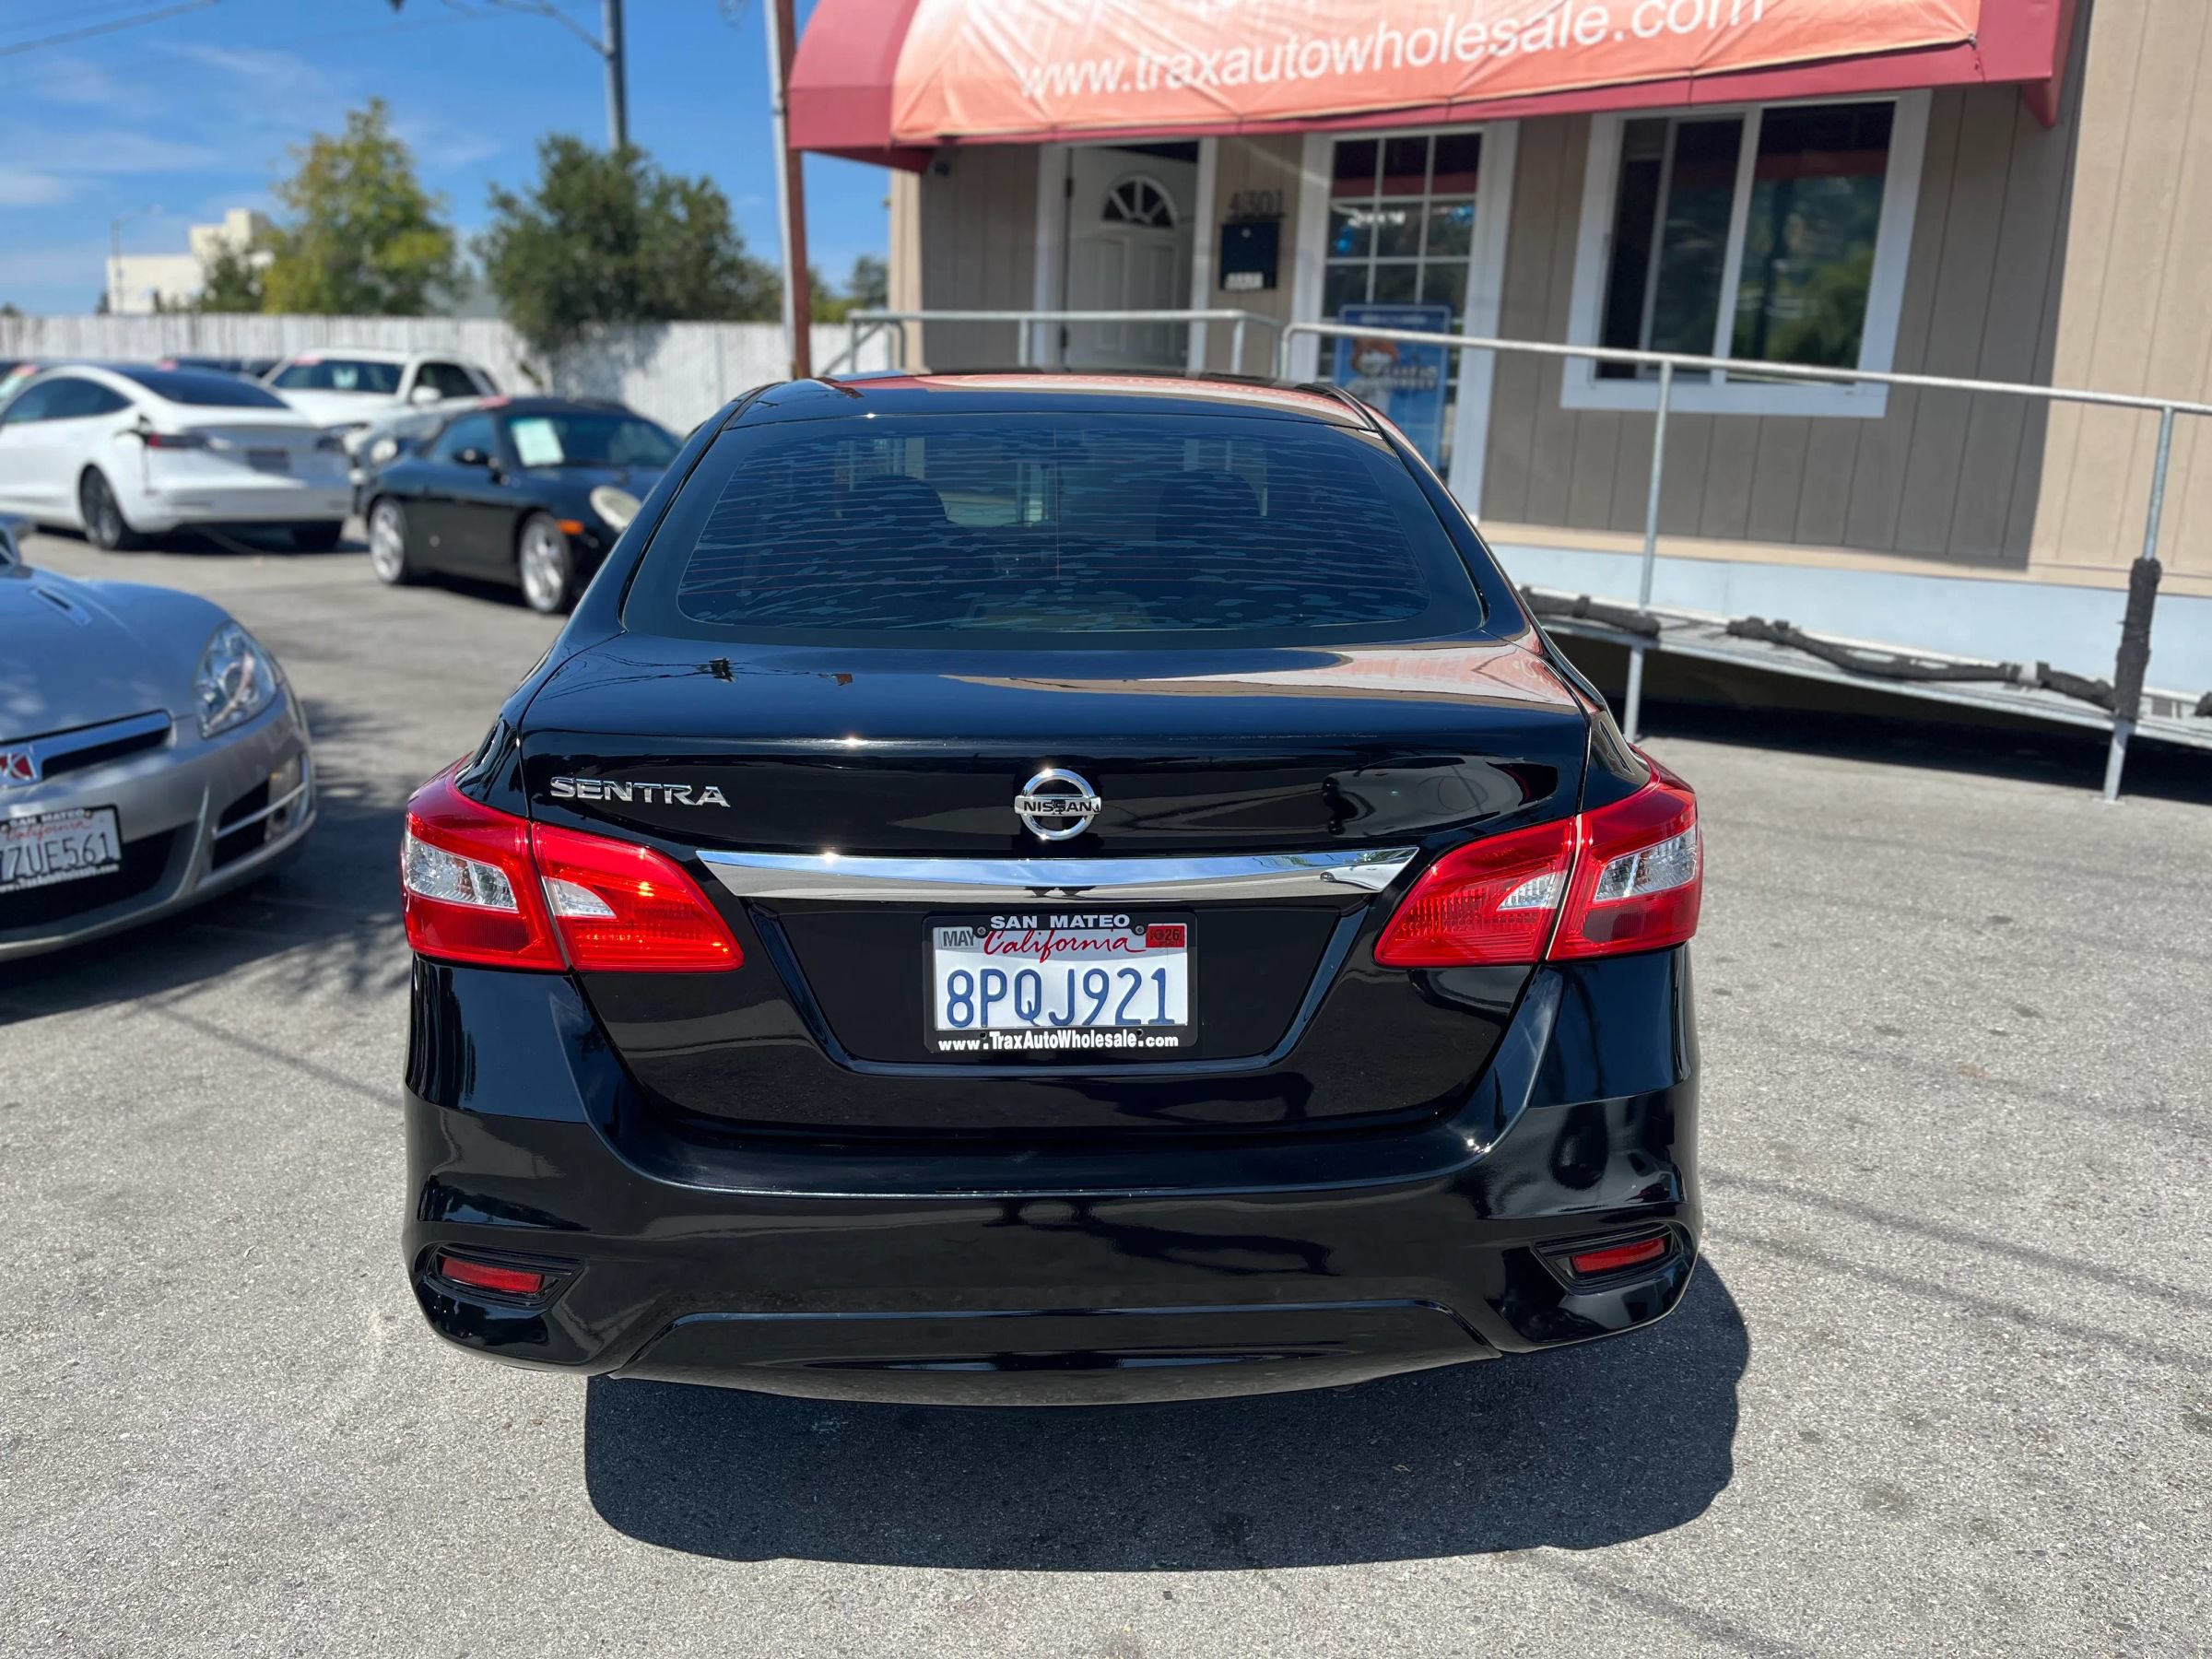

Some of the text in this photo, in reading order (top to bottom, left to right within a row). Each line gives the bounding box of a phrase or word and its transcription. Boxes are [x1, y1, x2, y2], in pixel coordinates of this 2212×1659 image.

[1018, 0, 1764, 98] www.traxautowholesale.com
[549, 776, 730, 807] SENTRA
[1023, 800, 1092, 812] NISSAN
[0, 831, 110, 881] ZUE561
[990, 914, 1130, 929] SAN MATEO
[1165, 928, 1180, 941] 26
[943, 930, 975, 947] MAY
[983, 929, 1147, 963] California
[947, 968, 1175, 1028] 8PQJ921
[938, 1029, 1179, 1051] www.TraxAutoWholesale.com
